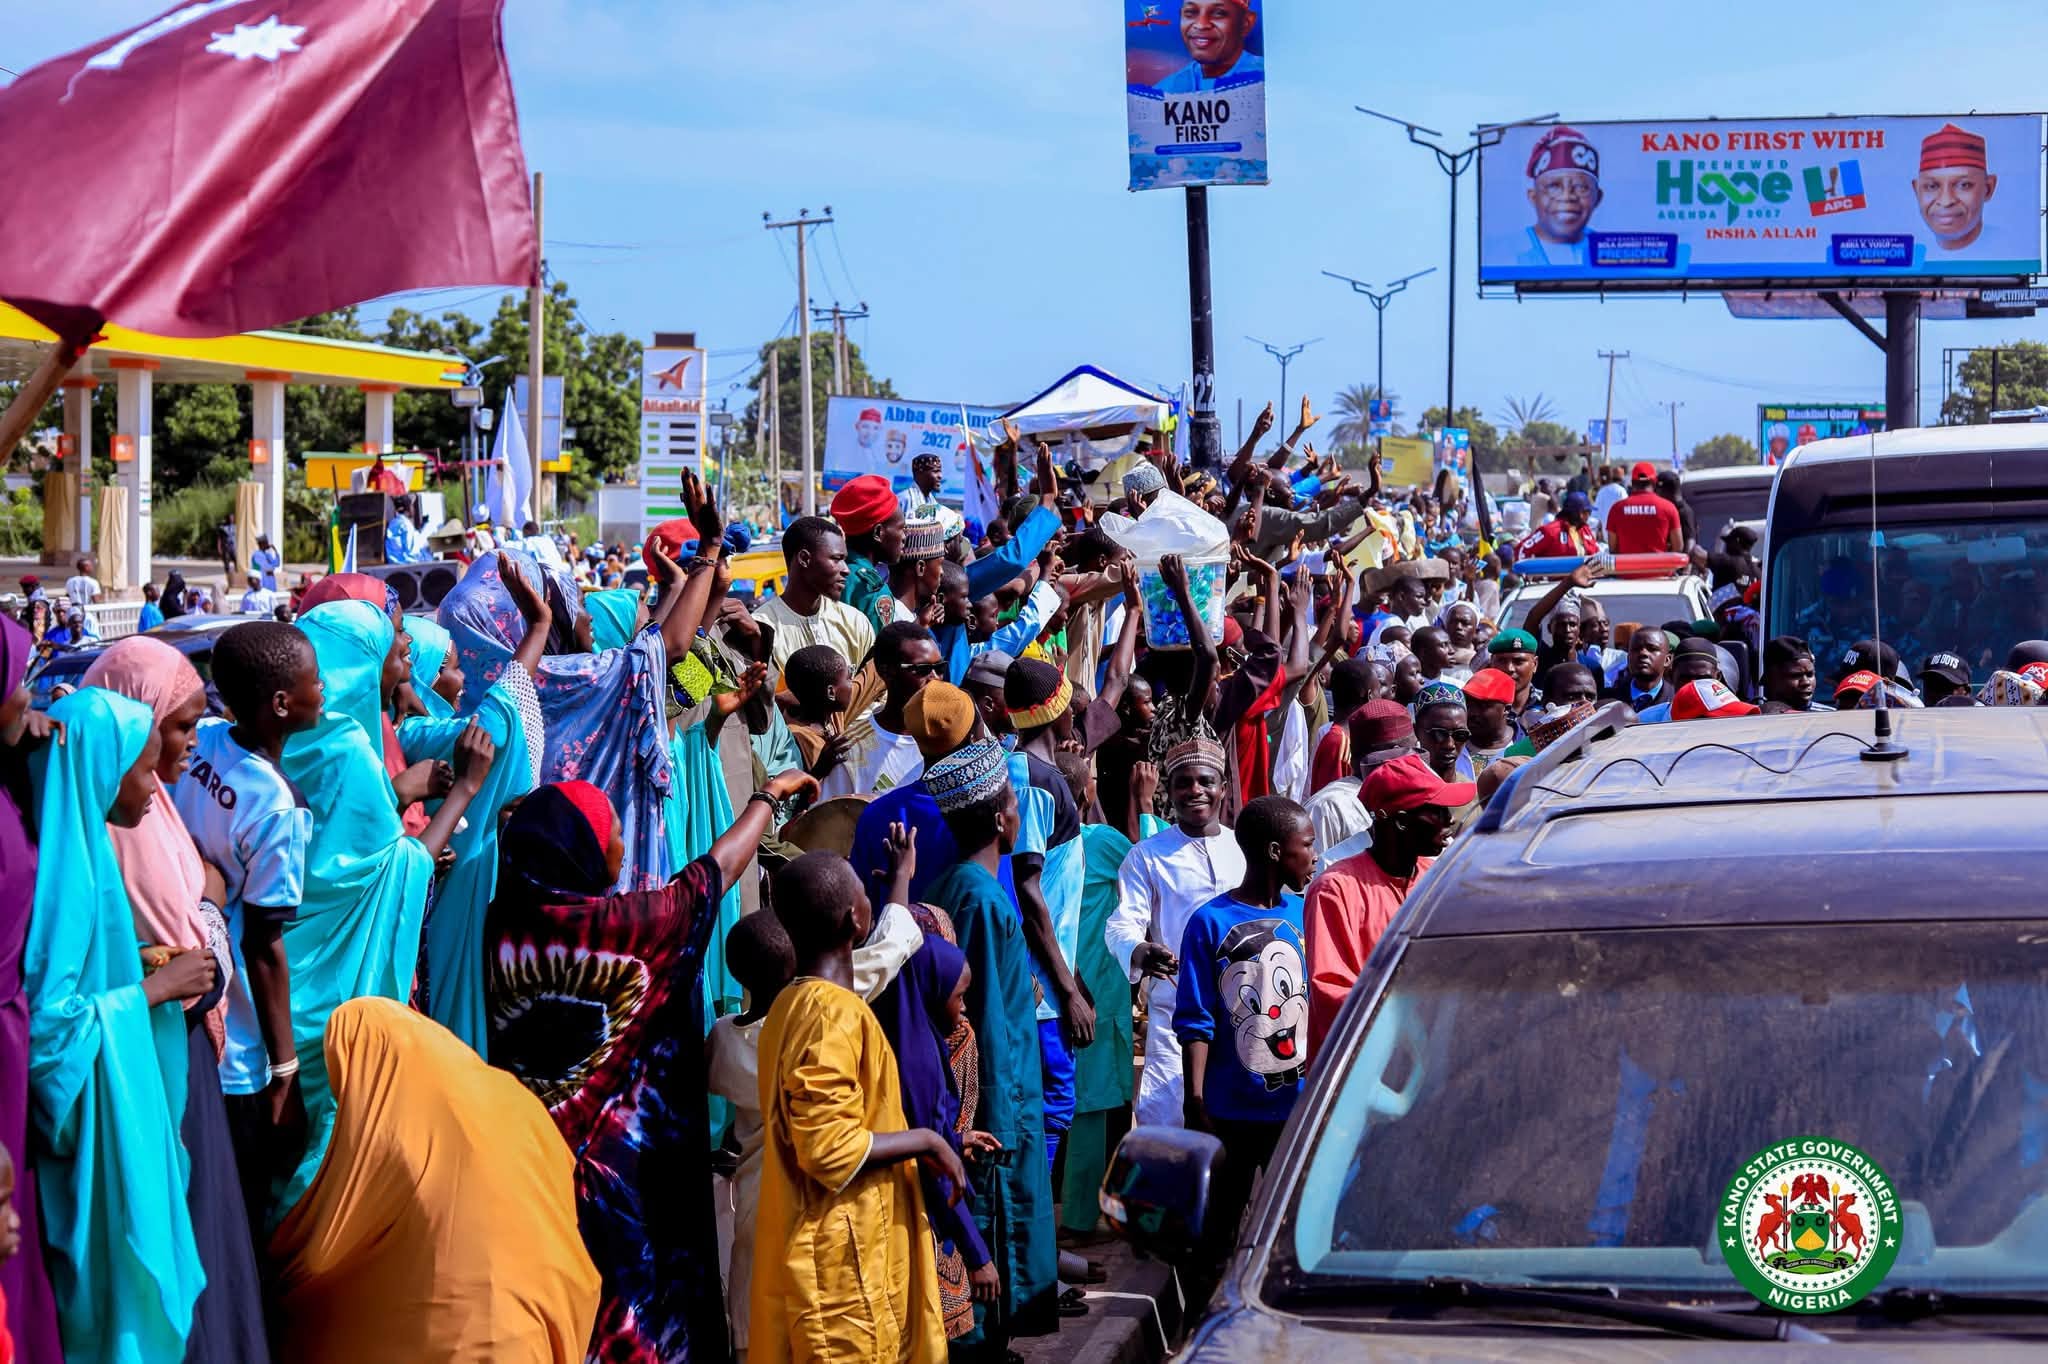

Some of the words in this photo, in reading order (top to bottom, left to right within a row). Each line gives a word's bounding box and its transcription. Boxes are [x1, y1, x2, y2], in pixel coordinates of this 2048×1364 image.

[1164, 100, 1230, 125] KANO
[1175, 125, 1220, 143] FIRST
[1641, 132, 1720, 152] KANO
[1727, 131, 1805, 150] FIRST
[1812, 130, 1885, 149] WITH
[1697, 159, 1789, 170] RENEWED
[1656, 159, 1794, 226] Hope
[1823, 198, 1854, 213] APC
[1657, 210, 1717, 220] AGENDA
[1706, 228, 1757, 240] INSHA
[1762, 227, 1817, 239] ALLAH
[1840, 249, 1906, 259] GOVERNOR
[884, 406, 926, 424] Abba
[922, 431, 953, 450] 2027
